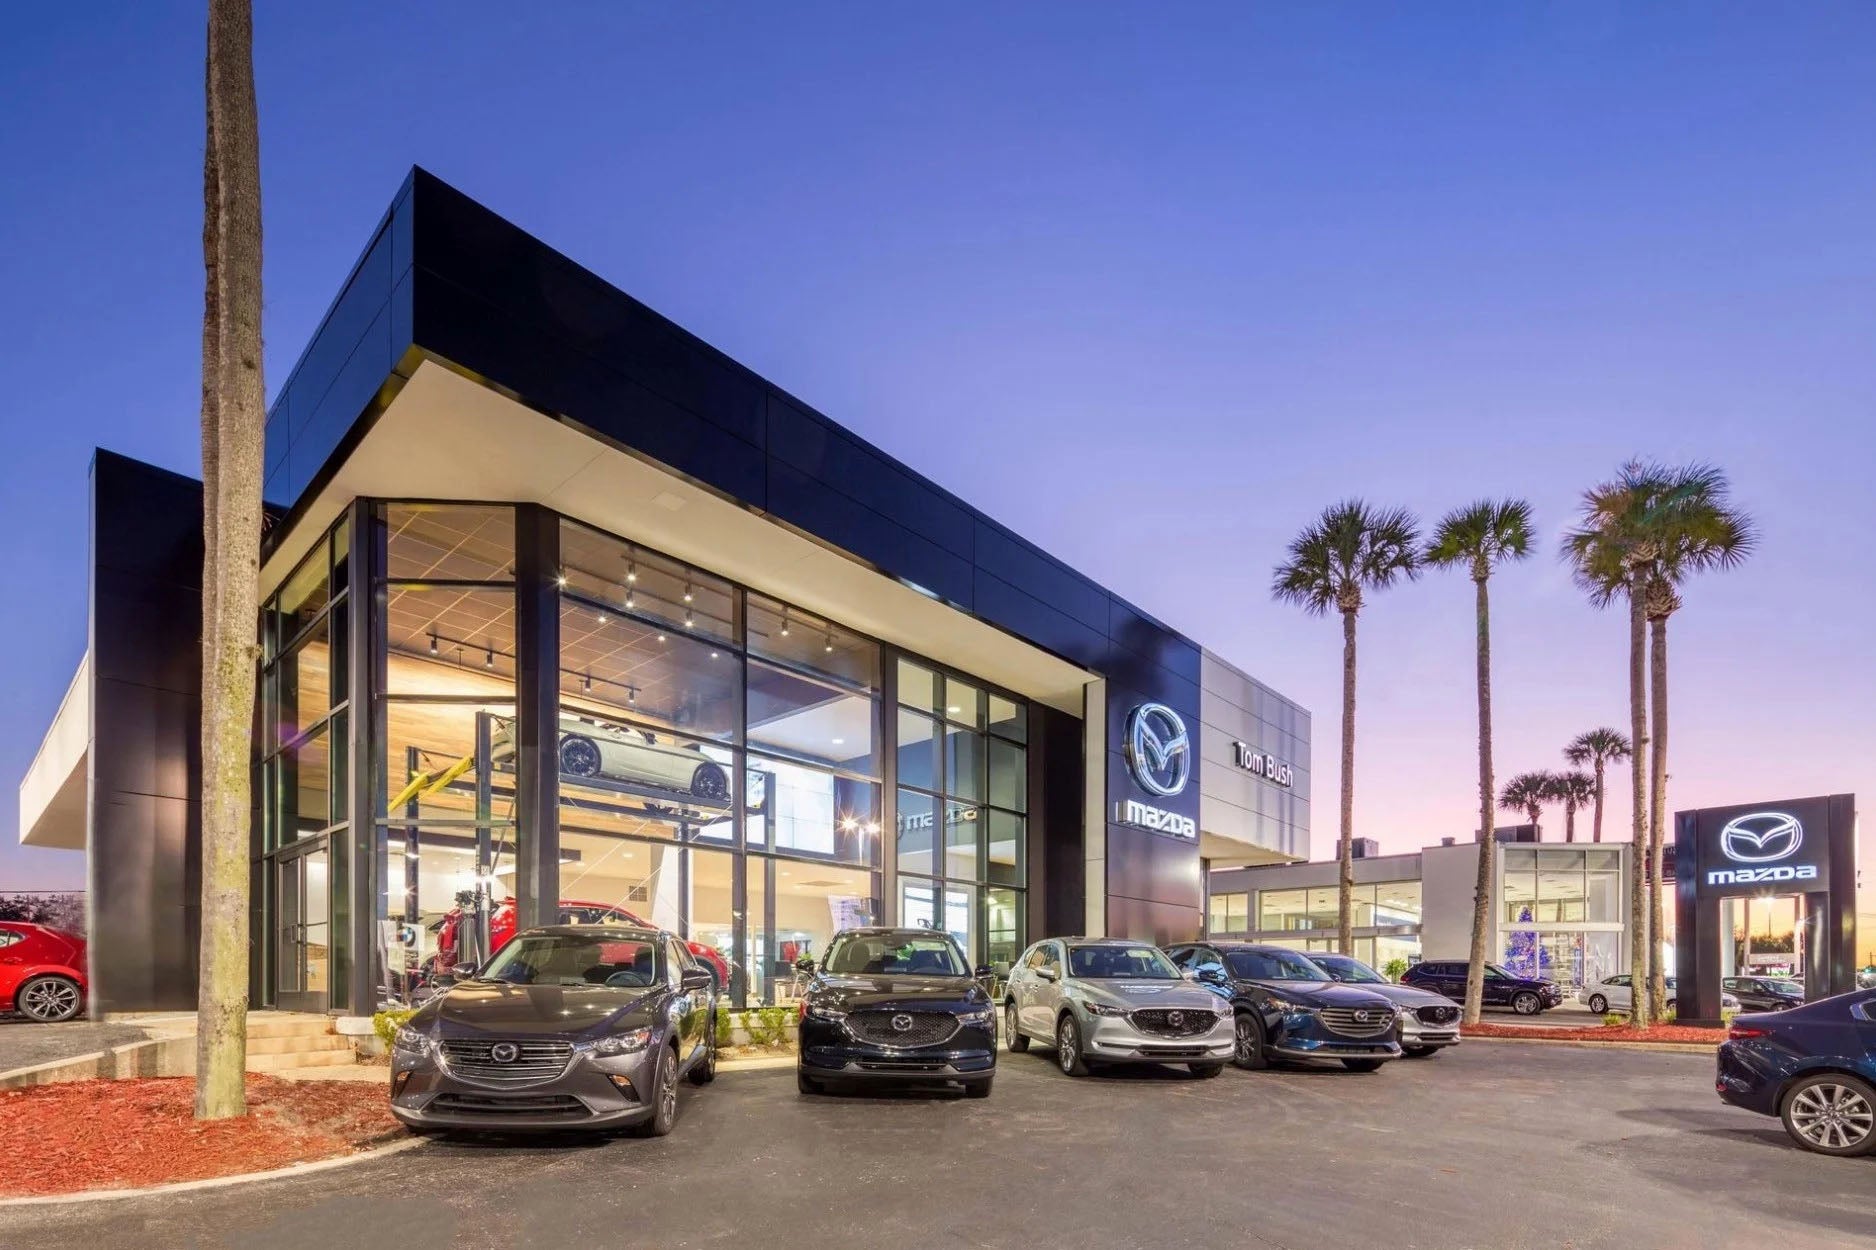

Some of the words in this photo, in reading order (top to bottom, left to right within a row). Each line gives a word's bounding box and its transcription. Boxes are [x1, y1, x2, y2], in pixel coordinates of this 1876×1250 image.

[1237, 741, 1264, 776] Tom
[1265, 752, 1293, 787] Bush
[906, 809, 978, 830] mada
[1126, 799, 1196, 839] mazda
[1707, 865, 1818, 885] mazda
